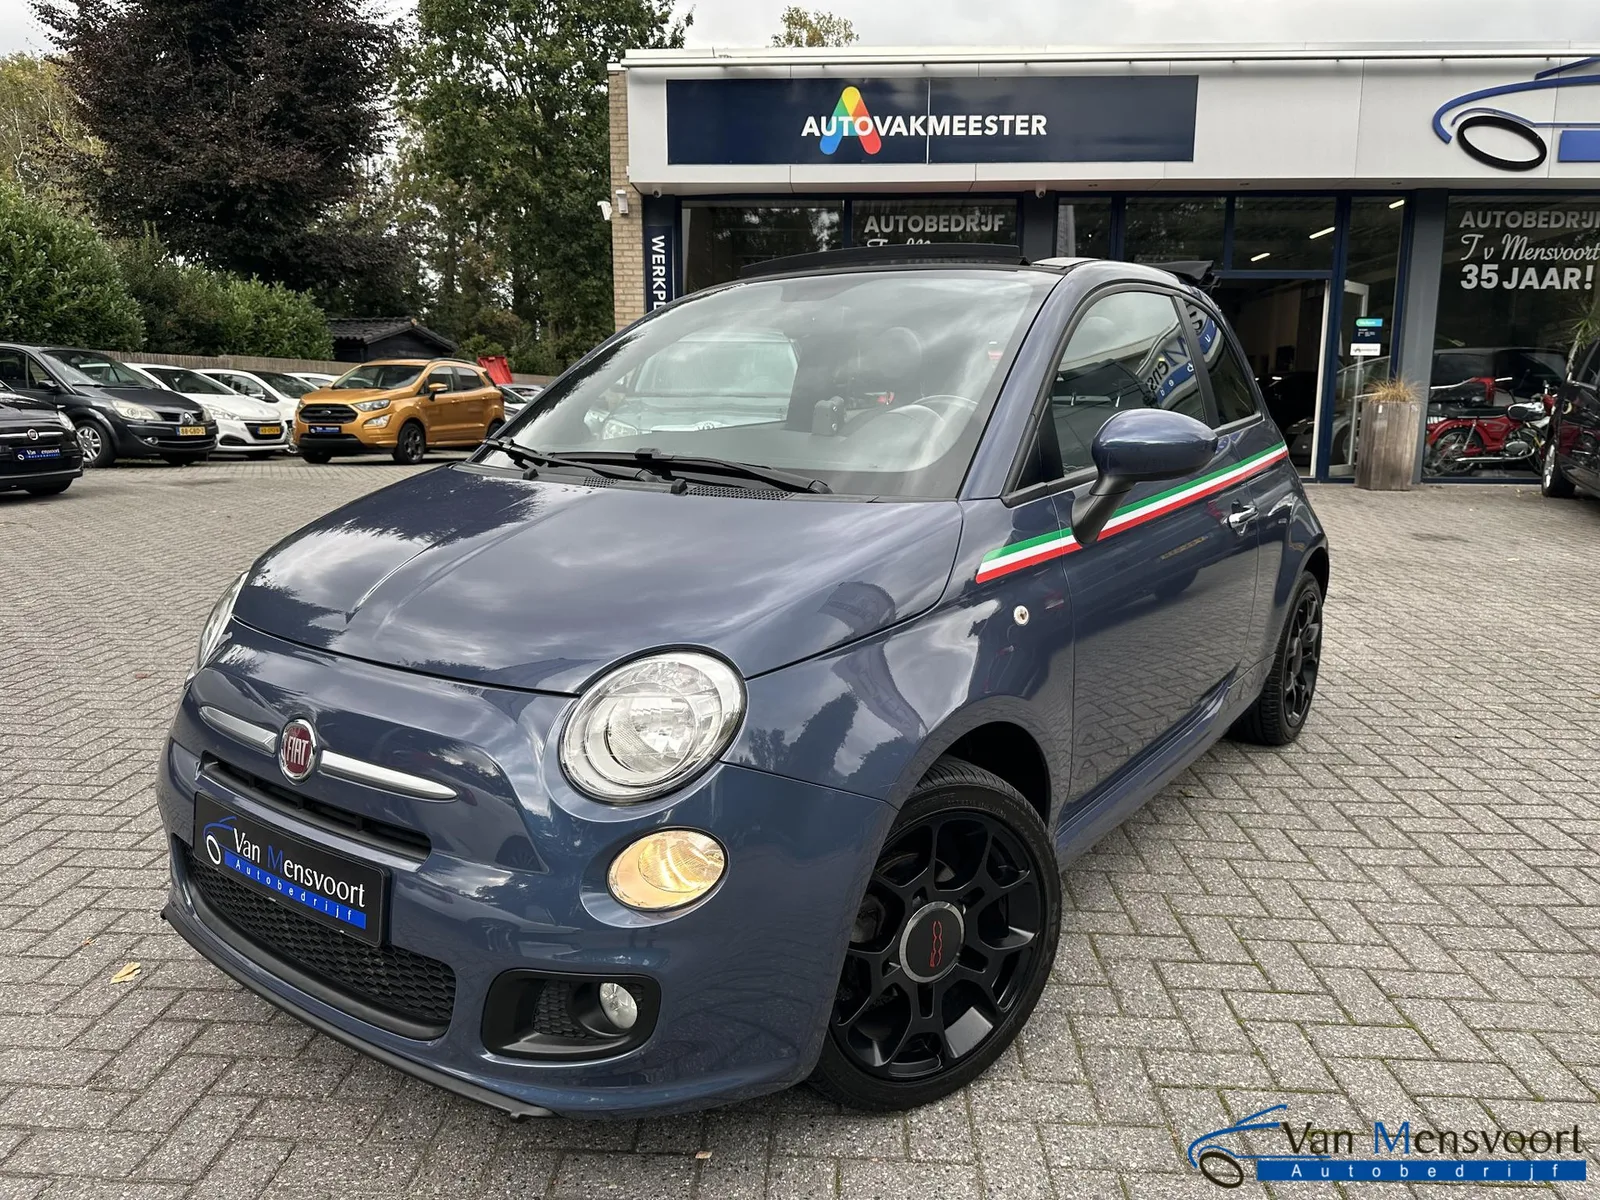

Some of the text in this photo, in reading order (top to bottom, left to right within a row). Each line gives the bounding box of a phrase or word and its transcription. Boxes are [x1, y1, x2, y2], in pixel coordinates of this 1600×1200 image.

[801, 115, 1047, 137] AUTOVAKMEESTER
[864, 214, 1005, 233] AUTOBEDRIJF
[1501, 233, 1600, 260] Mensvoort
[1460, 263, 1594, 290] 35 JAAR!
[286, 735, 310, 766] FIAT
[233, 827, 365, 908] Van Mensvoort
[235, 859, 352, 918] Autobedrijf
